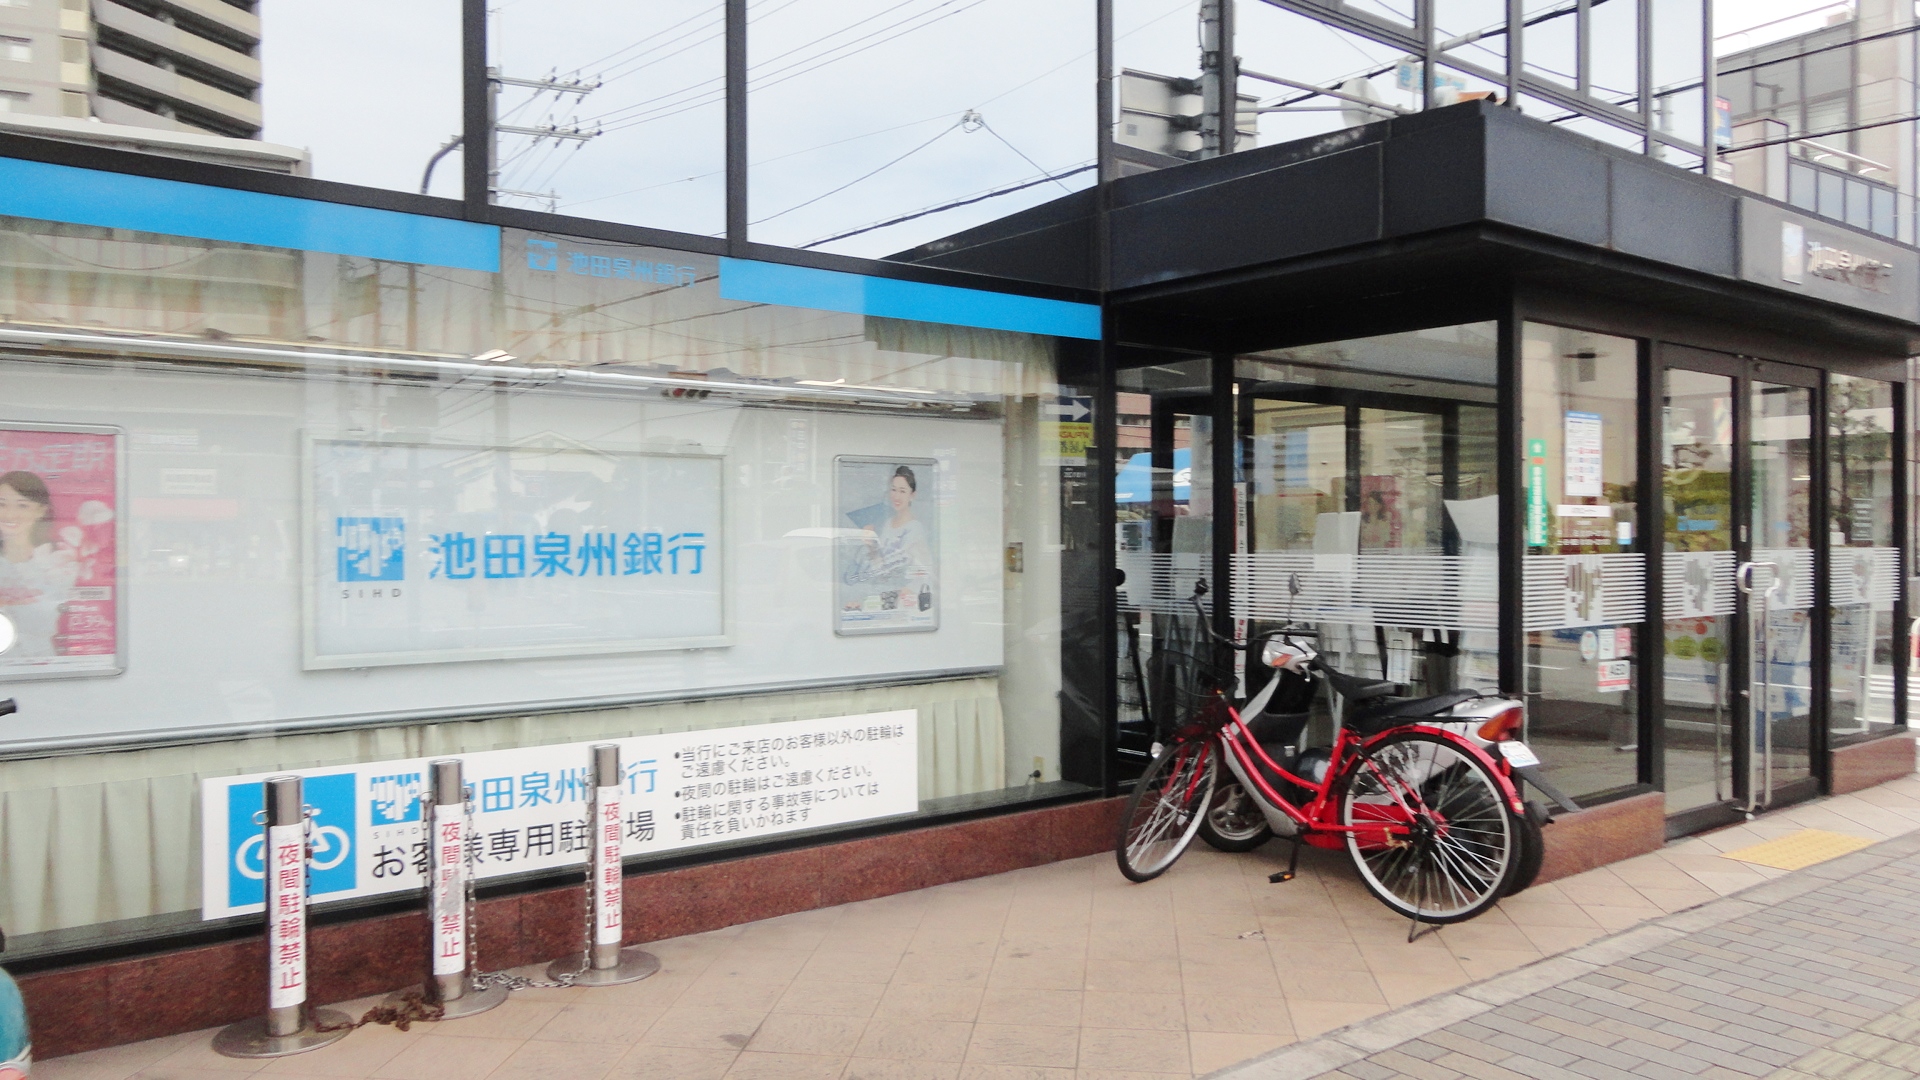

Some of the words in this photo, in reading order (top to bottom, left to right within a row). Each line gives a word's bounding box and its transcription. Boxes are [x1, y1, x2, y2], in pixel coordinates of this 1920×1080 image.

[567, 252, 697, 288] 池田泉州銀行
[428, 531, 708, 580] 池田泉州銀行
[340, 587, 403, 599] SIHD
[681, 724, 905, 763] 当行にご来店のお客様以外の駐輪は
[681, 754, 791, 779] ご遠慮ください。
[681, 764, 873, 802] 夜間の駐輪はご遠慮ください。
[462, 758, 658, 815] 田泉州行
[681, 782, 880, 823] 駐輪に関する事故等については
[372, 826, 419, 840] SIHD
[681, 807, 813, 841] 責任を負いかねます
[603, 801, 621, 929] 夜間駐輪禁止
[440, 821, 462, 958] 夜間禁止
[277, 843, 302, 990] 夜間駐輪禁止
